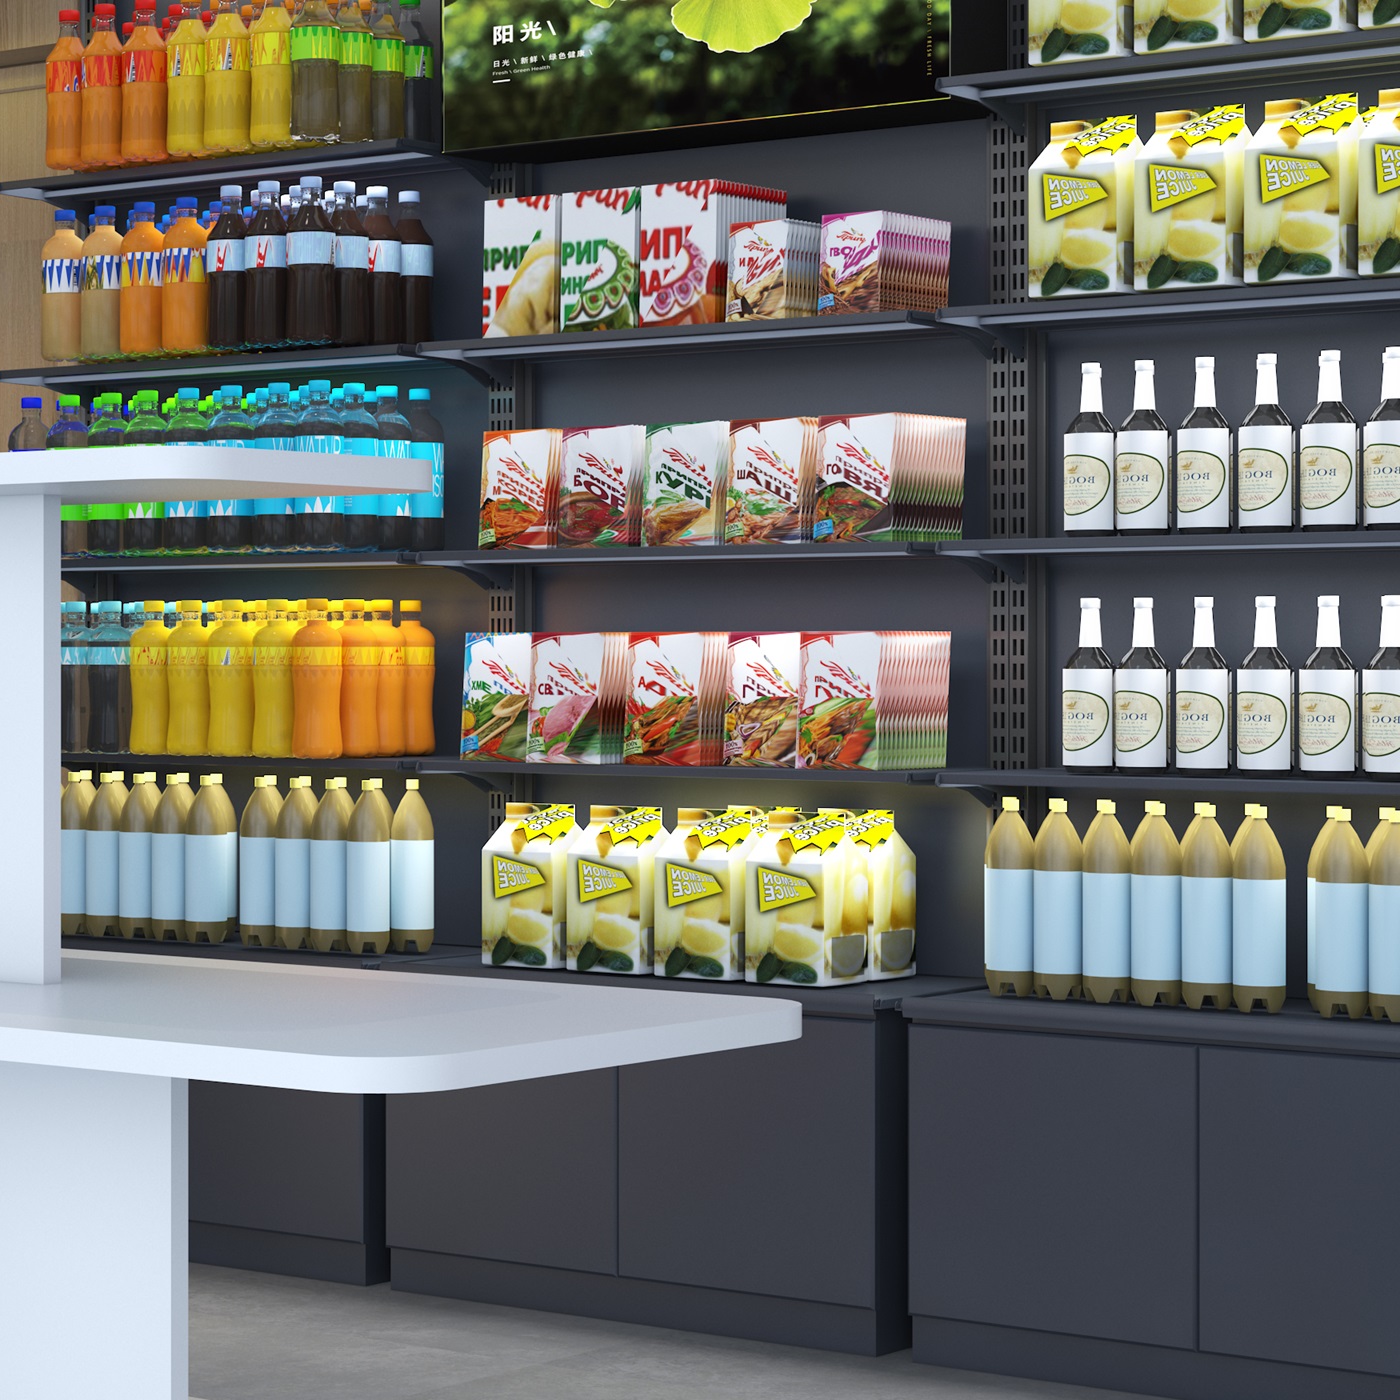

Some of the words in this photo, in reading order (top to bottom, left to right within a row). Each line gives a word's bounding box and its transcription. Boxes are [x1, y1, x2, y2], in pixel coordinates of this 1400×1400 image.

[493, 21, 542, 46] 阳光
[494, 60, 510, 68] 日光
[520, 56, 538, 64] 新鲜
[549, 50, 584, 60] 绿色健康
